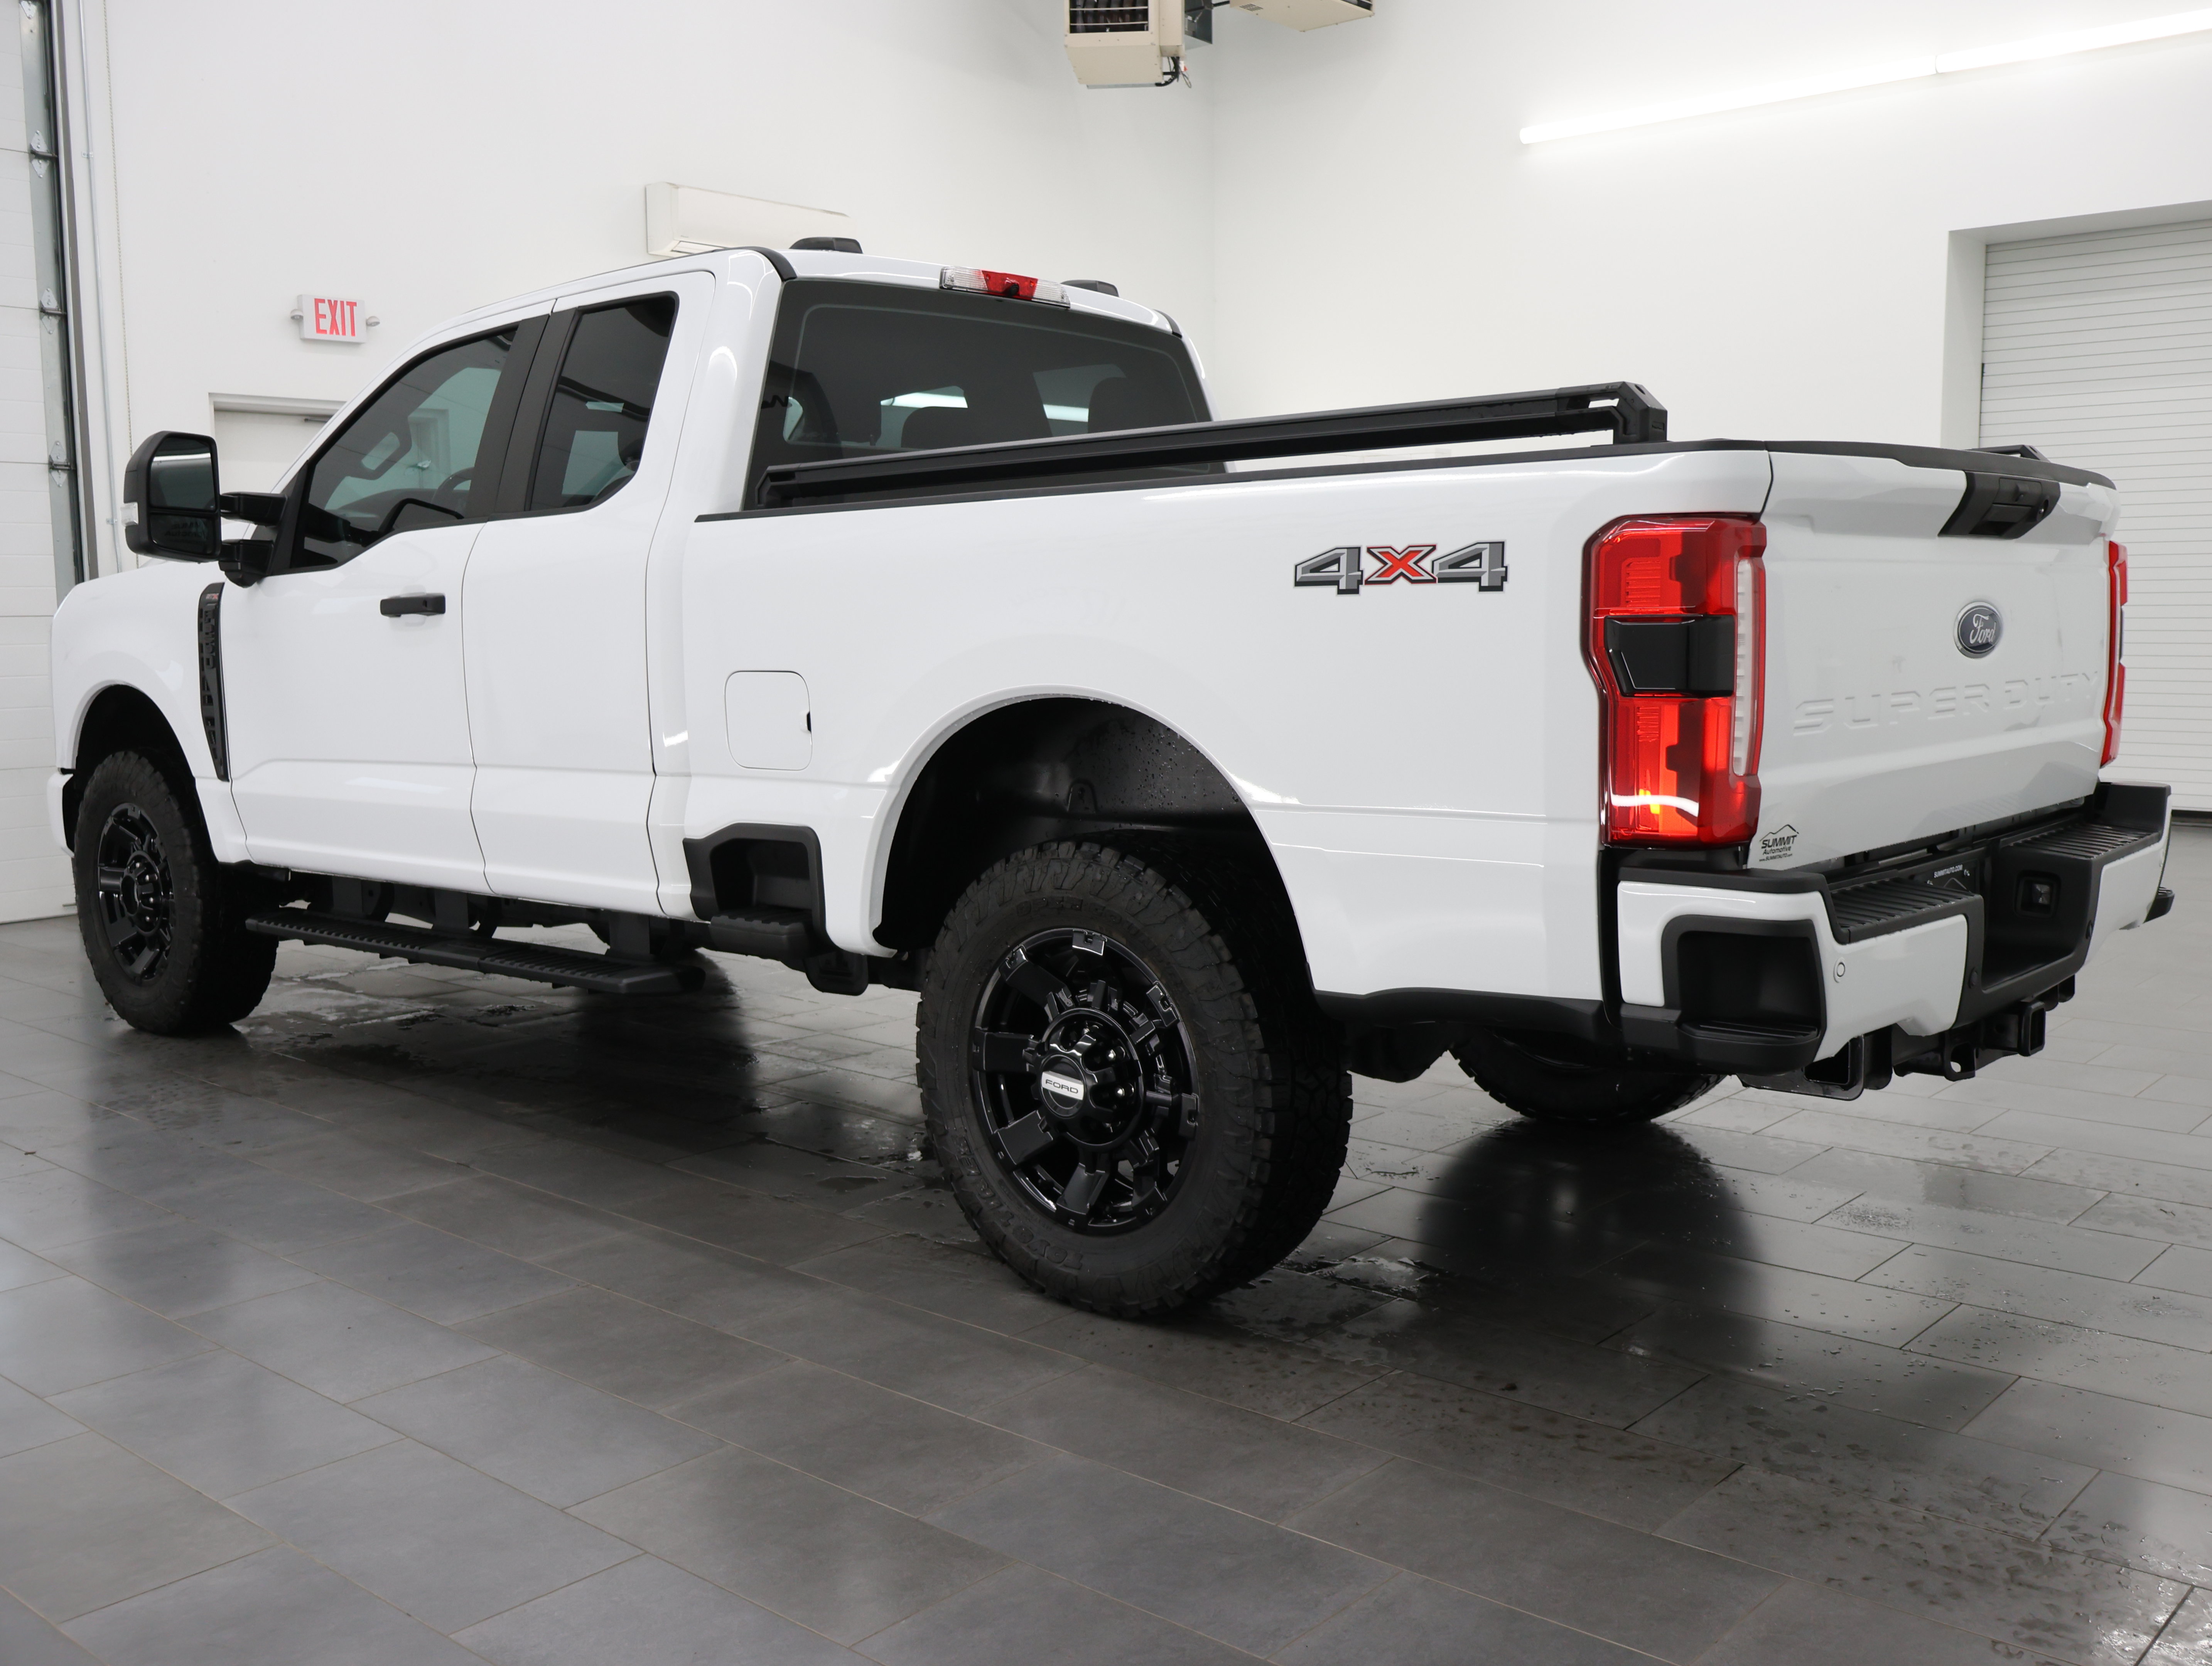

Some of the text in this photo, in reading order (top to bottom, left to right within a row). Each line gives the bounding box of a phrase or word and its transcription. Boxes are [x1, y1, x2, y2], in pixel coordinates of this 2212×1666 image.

[314, 298, 357, 337] EXIT
[1969, 614, 1997, 644] Ford
[1794, 671, 2098, 736] SUPER DUTY
[1761, 835, 1797, 849] SUMMIT
[1763, 846, 1792, 855] Automotive
[1045, 1079, 1078, 1094] FORD
[1012, 1226, 1083, 1271] TOYO
